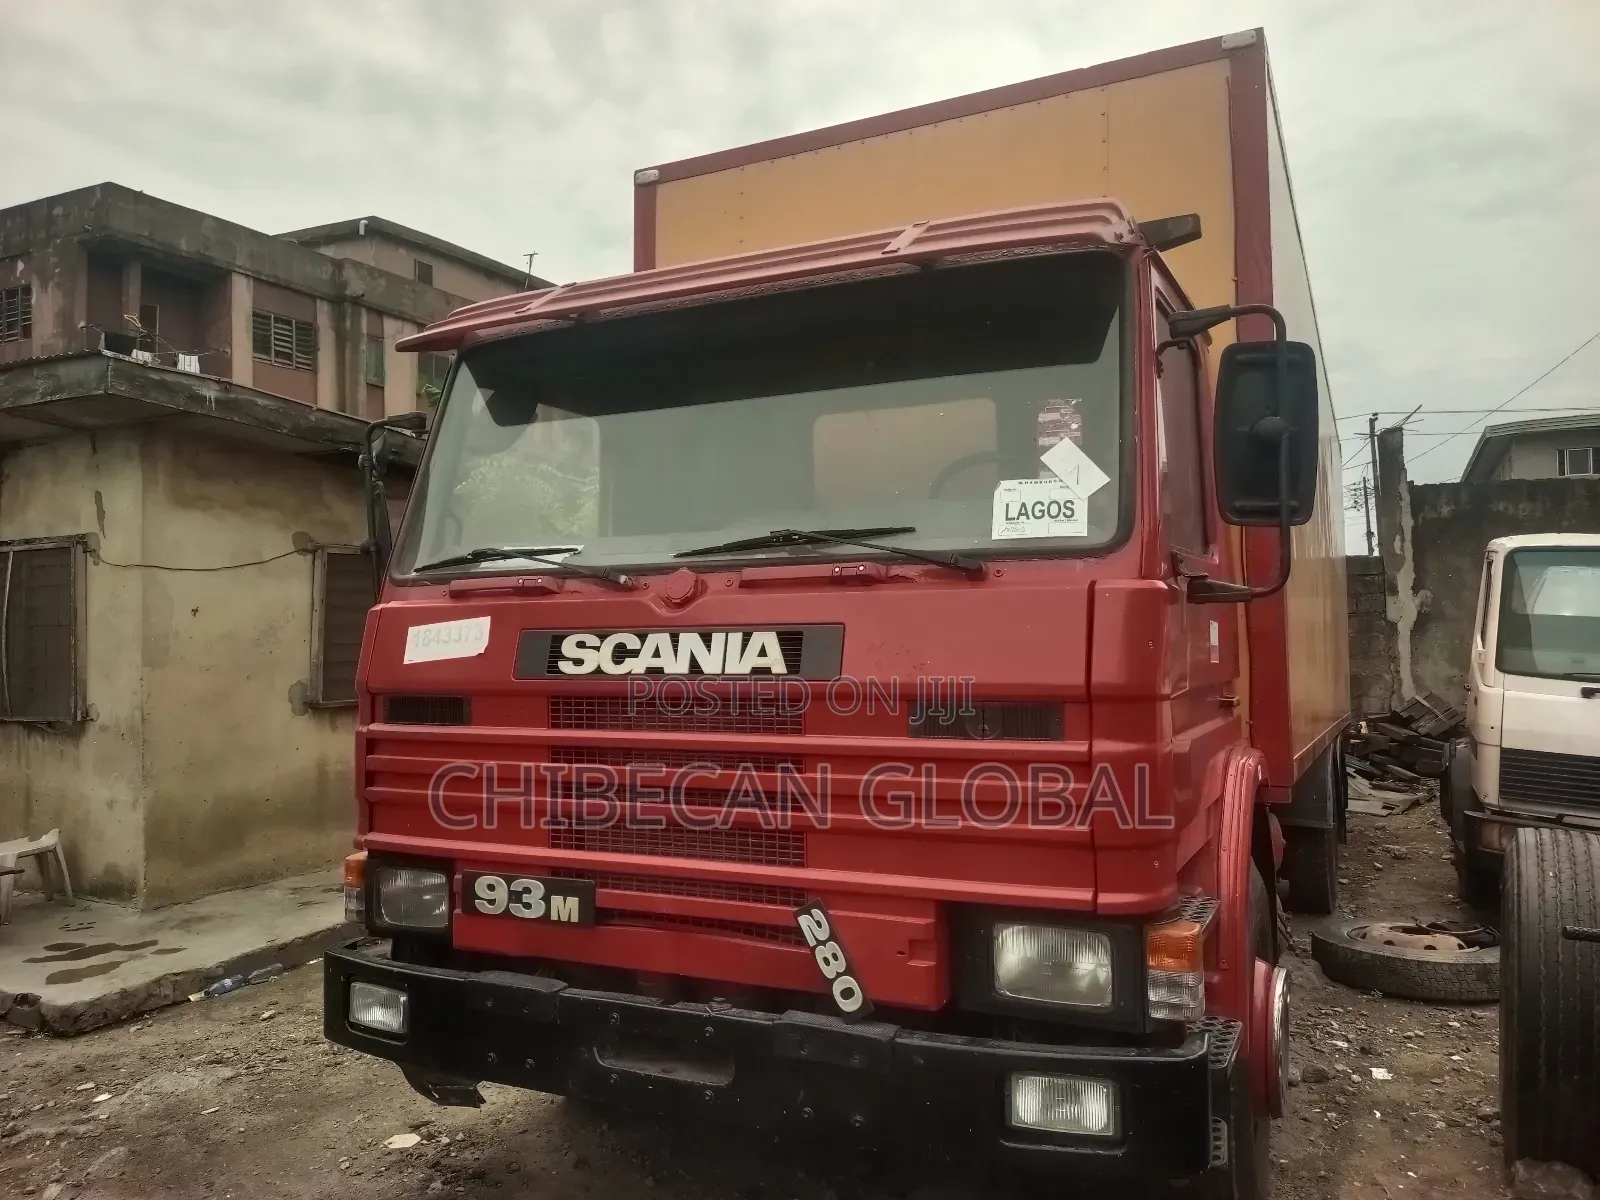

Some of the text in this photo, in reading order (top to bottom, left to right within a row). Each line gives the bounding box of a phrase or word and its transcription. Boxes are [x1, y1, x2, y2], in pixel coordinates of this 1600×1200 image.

[1005, 500, 1075, 521] LAGOS
[558, 631, 788, 675] SCANIA
[797, 907, 863, 1012] 280
